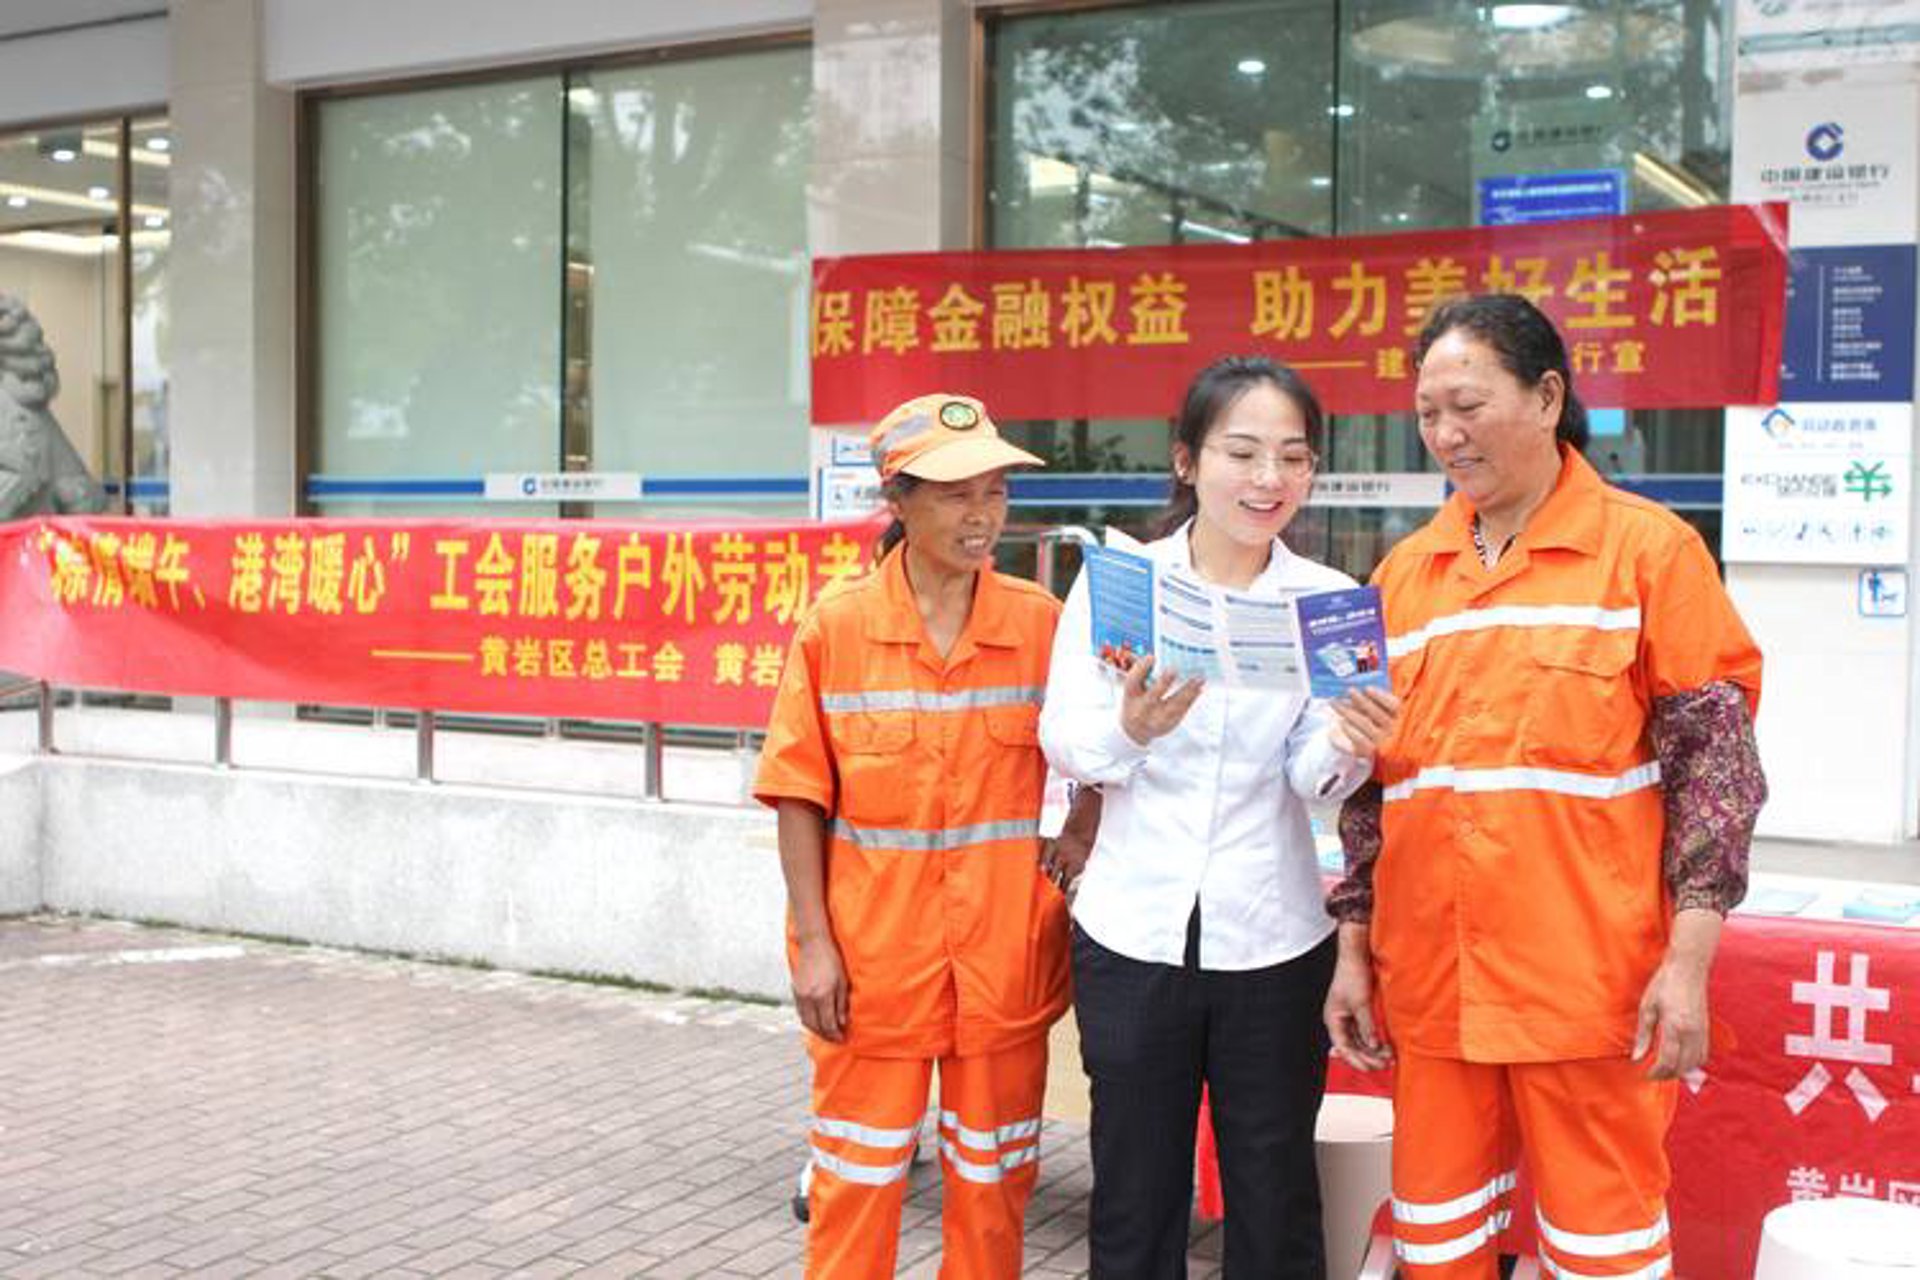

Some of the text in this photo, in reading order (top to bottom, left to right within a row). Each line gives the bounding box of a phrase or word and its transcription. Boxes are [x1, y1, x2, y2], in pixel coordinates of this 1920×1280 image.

[810, 246, 1722, 358] 保障金融权益 助力美好生活
